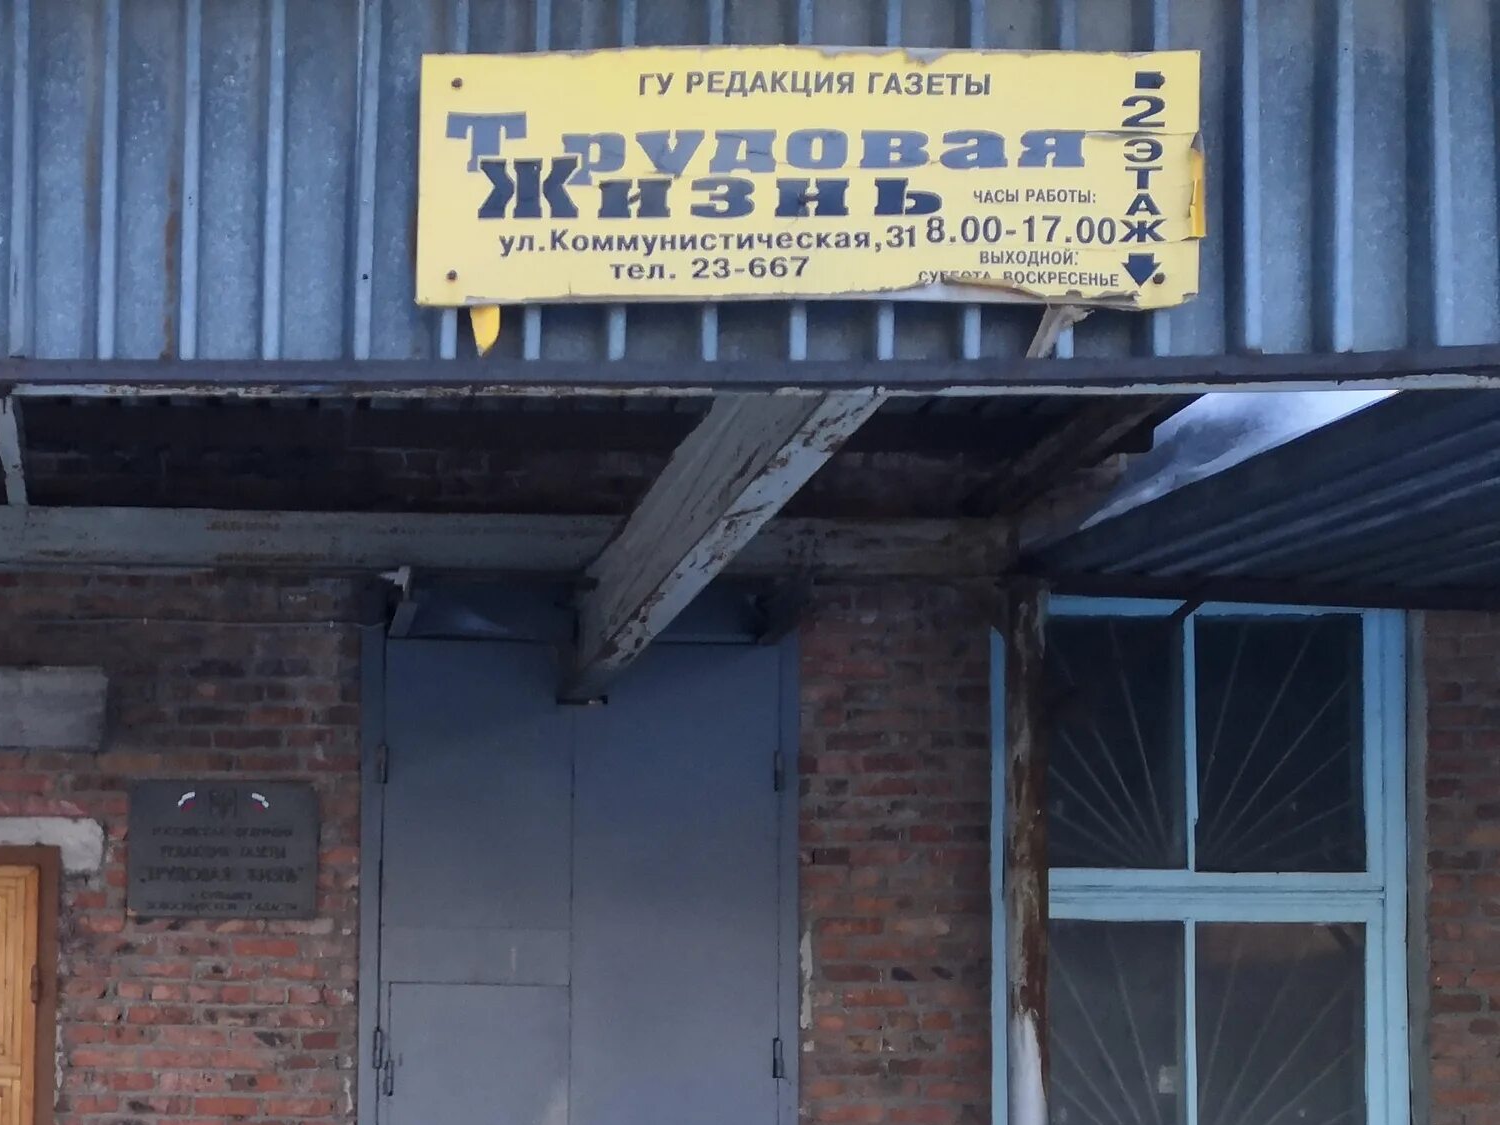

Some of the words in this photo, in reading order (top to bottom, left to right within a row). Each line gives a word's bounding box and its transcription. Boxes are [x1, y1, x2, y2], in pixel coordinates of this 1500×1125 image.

[639, 73, 675, 96] ГУ
[686, 71, 855, 98] РЕДАКЦИЯ
[867, 72, 991, 97] ГАЗЕТЫ
[1122, 95, 1166, 128] 2
[446, 111, 1087, 186] Трудовая
[477, 157, 942, 219] Жизнь
[973, 189, 1019, 203] ЧАСЫ
[1025, 189, 1097, 204] РАБОТЫ:
[1118, 138, 1167, 243] ЭТАЖ
[926, 215, 1117, 245] 8.00-17.00
[610, 260, 677, 280] тел.
[691, 257, 809, 279] 23-667
[979, 249, 1079, 267] ВЫХОДНОЙ:
[1003, 271, 1119, 287] ВОСКРЕСЕНЬЕ
